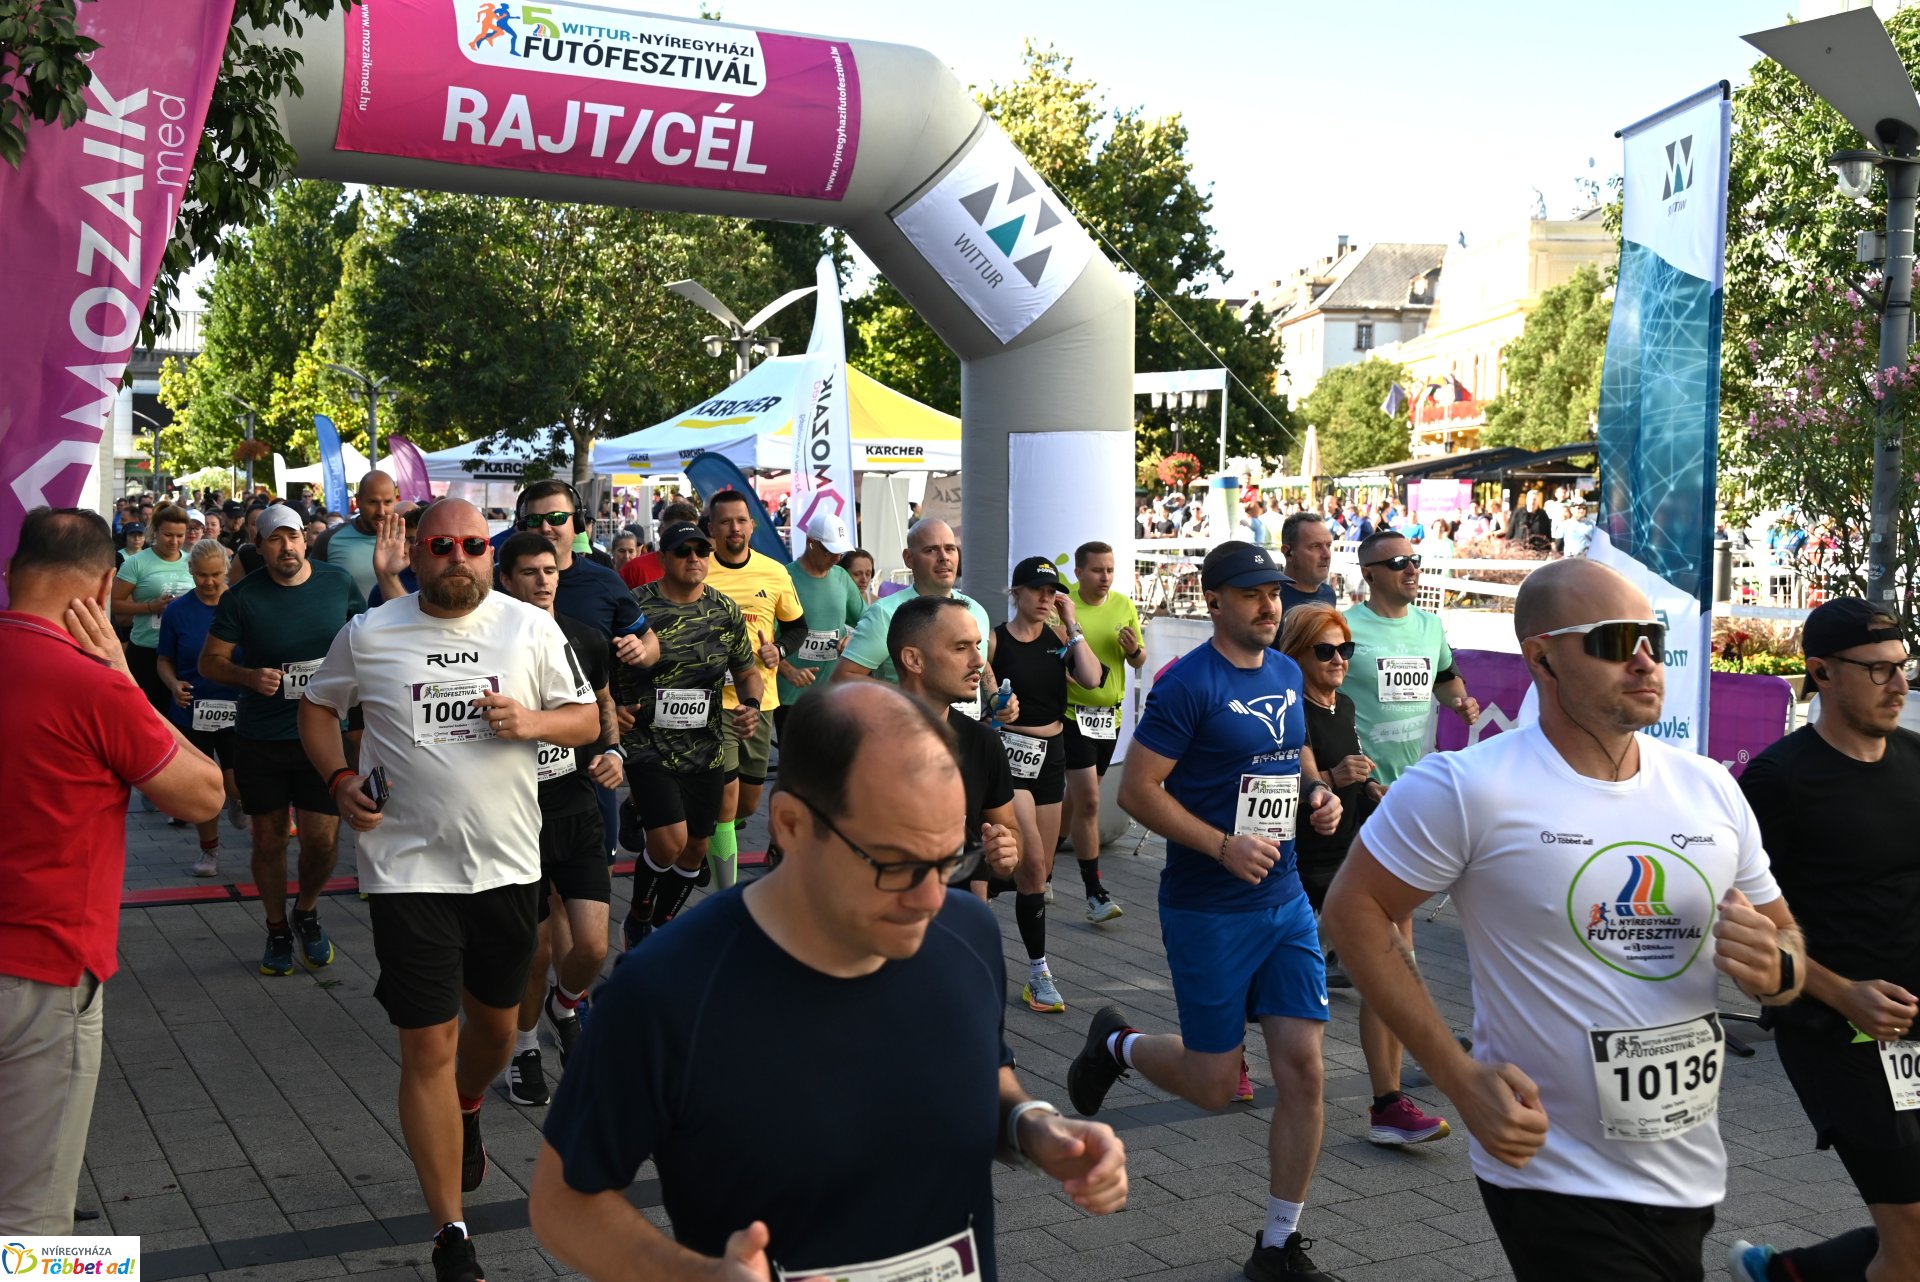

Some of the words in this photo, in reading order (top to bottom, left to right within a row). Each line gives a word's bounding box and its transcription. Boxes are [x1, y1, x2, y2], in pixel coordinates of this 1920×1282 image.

[562, 22, 755, 58] WITTUR-NYÍREGYHÁZI
[359, 4, 373, 111] www.mozaikmed.hu
[522, 35, 758, 87] FUTÓFESZTIVÁL
[825, 46, 847, 192] www.nyiregyhazifutofesztival.hu
[152, 89, 186, 188] med
[442, 85, 768, 175] RAJT/CÉL
[61, 69, 149, 430] MOZAIK
[953, 232, 1004, 289] WITTUR
[691, 396, 782, 417] KÄRCHER
[865, 445, 924, 456] KÄRCHER
[484, 461, 523, 474] KÄRC
[804, 639, 832, 651] 1013
[427, 651, 479, 668] RUN
[290, 674, 313, 688] 10
[1384, 672, 1429, 687] 10000
[199, 709, 237, 722] 10095
[422, 698, 488, 724] 1002
[662, 702, 706, 715] 10060
[1079, 715, 1113, 729] 10015
[537, 746, 570, 766] 028
[1007, 747, 1041, 766] 0066
[1619, 917, 1681, 926] NYÍREGYHÁZI
[1588, 925, 1702, 941] FUTÓFESZTIVÁL
[1613, 1049, 1718, 1102] 10136
